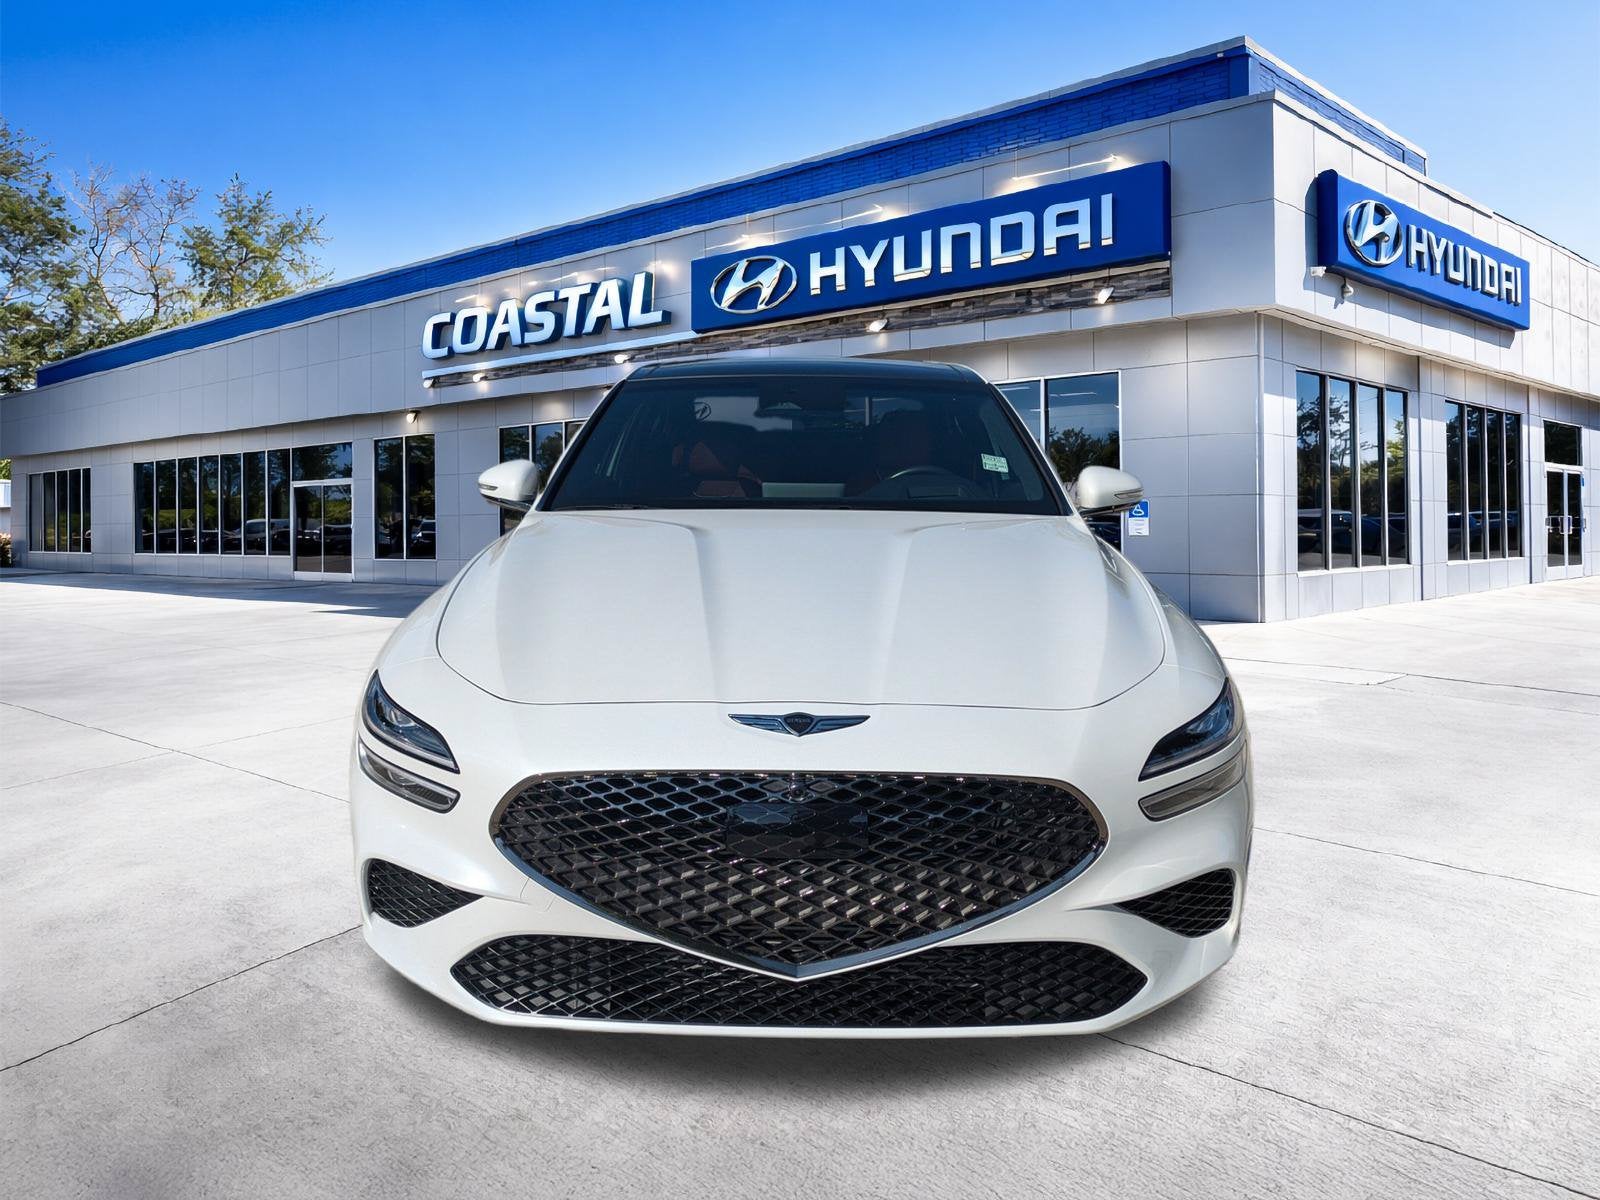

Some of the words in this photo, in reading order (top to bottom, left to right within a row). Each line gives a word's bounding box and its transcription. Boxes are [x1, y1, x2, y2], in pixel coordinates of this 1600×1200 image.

[809, 193, 1113, 296] HYUNDAI
[1406, 223, 1522, 306] HYUNDAI
[422, 271, 667, 360] COASTAL
